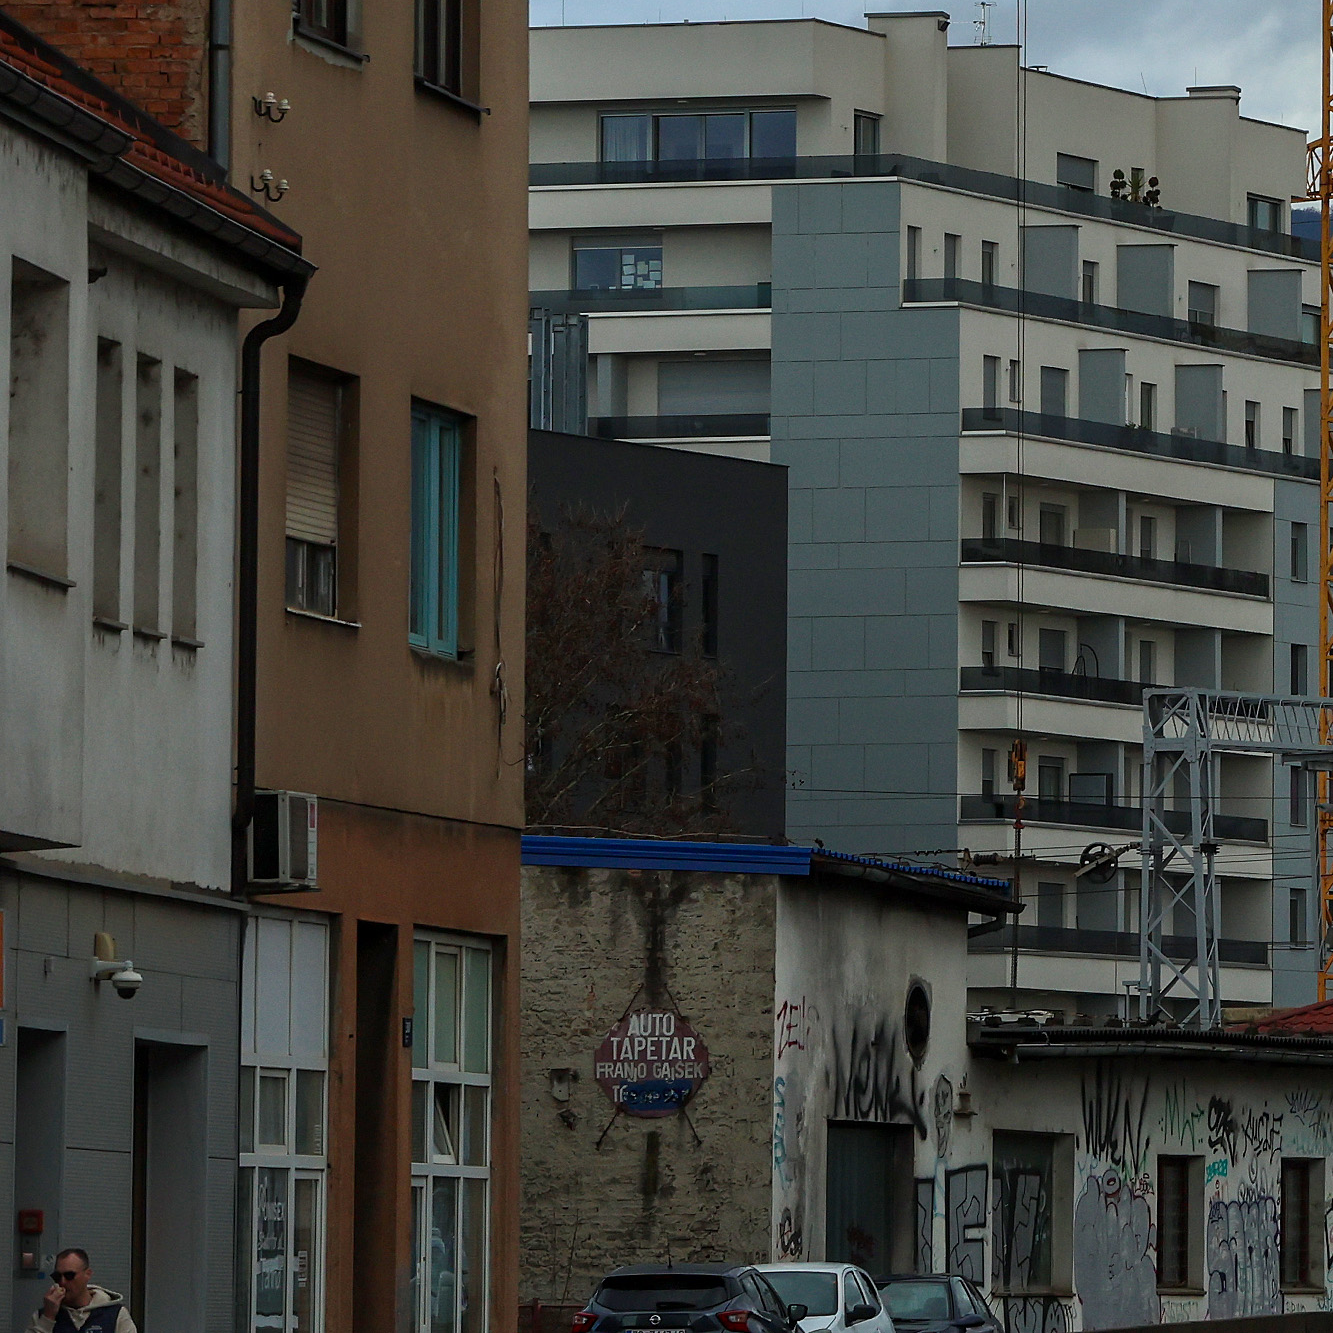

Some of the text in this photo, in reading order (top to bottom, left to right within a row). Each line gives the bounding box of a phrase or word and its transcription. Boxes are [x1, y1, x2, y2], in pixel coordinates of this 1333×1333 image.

[627, 1012, 675, 1037] AUTO
[610, 1036, 696, 1061] TAPETAR
[596, 1062, 647, 1082] FRANJO
